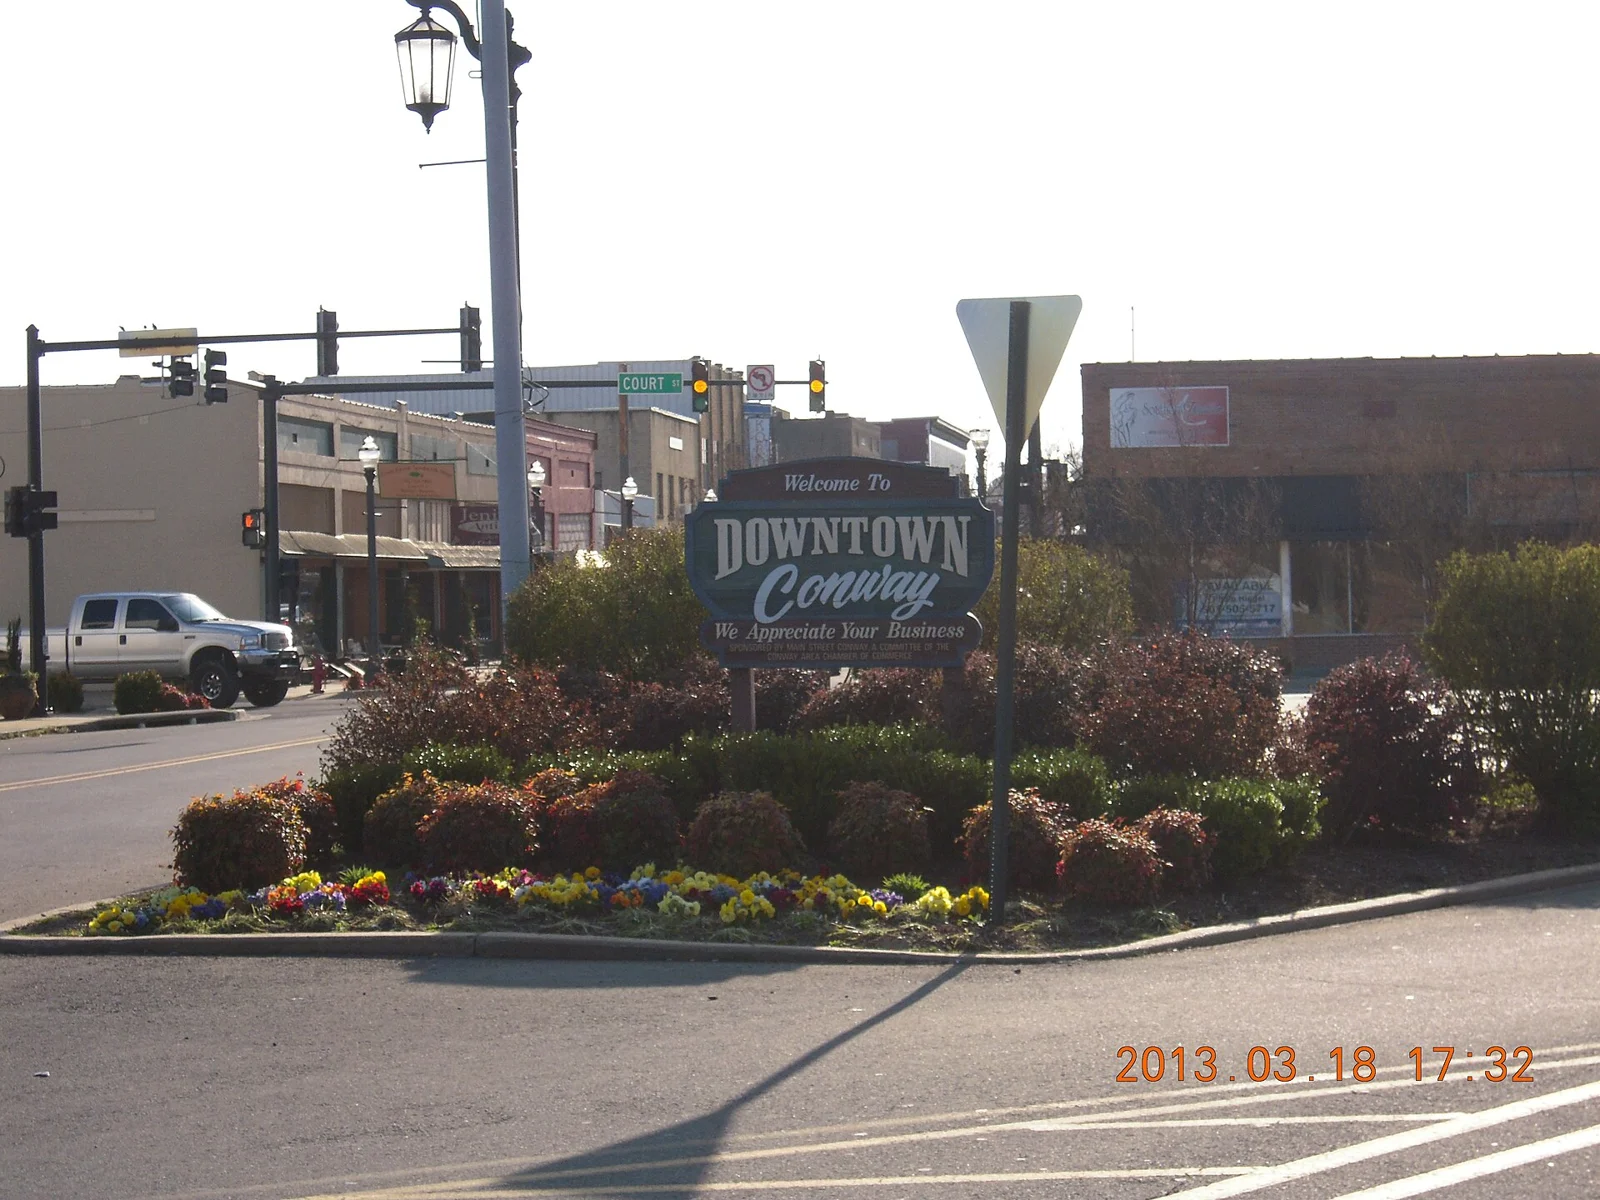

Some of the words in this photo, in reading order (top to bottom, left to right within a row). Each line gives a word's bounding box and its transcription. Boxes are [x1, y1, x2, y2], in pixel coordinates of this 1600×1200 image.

[623, 376, 665, 390] COURT
[671, 379, 681, 387] ST
[784, 474, 860, 492] Welcome
[867, 473, 891, 491] To
[713, 515, 972, 581] DOWNTOWN
[753, 563, 941, 624] Conway
[714, 622, 739, 640] We
[745, 622, 836, 643] Appreciate
[841, 621, 879, 640] Your
[885, 620, 965, 639] Business
[728, 643, 772, 652] SPONSORED
[773, 643, 784, 652] BY
[786, 643, 806, 652] MAIN
[808, 643, 835, 652] STREET
[871, 643, 878, 652] A
[879, 643, 921, 651] COMMITTEE
[924, 643, 934, 651] OF
[936, 643, 950, 651] THE
[767, 652, 798, 661] CONWAY
[801, 652, 821, 661] AREA
[822, 652, 858, 661] CHAMBER
[860, 652, 870, 660] OF
[871, 651, 913, 660] COMMERCE
